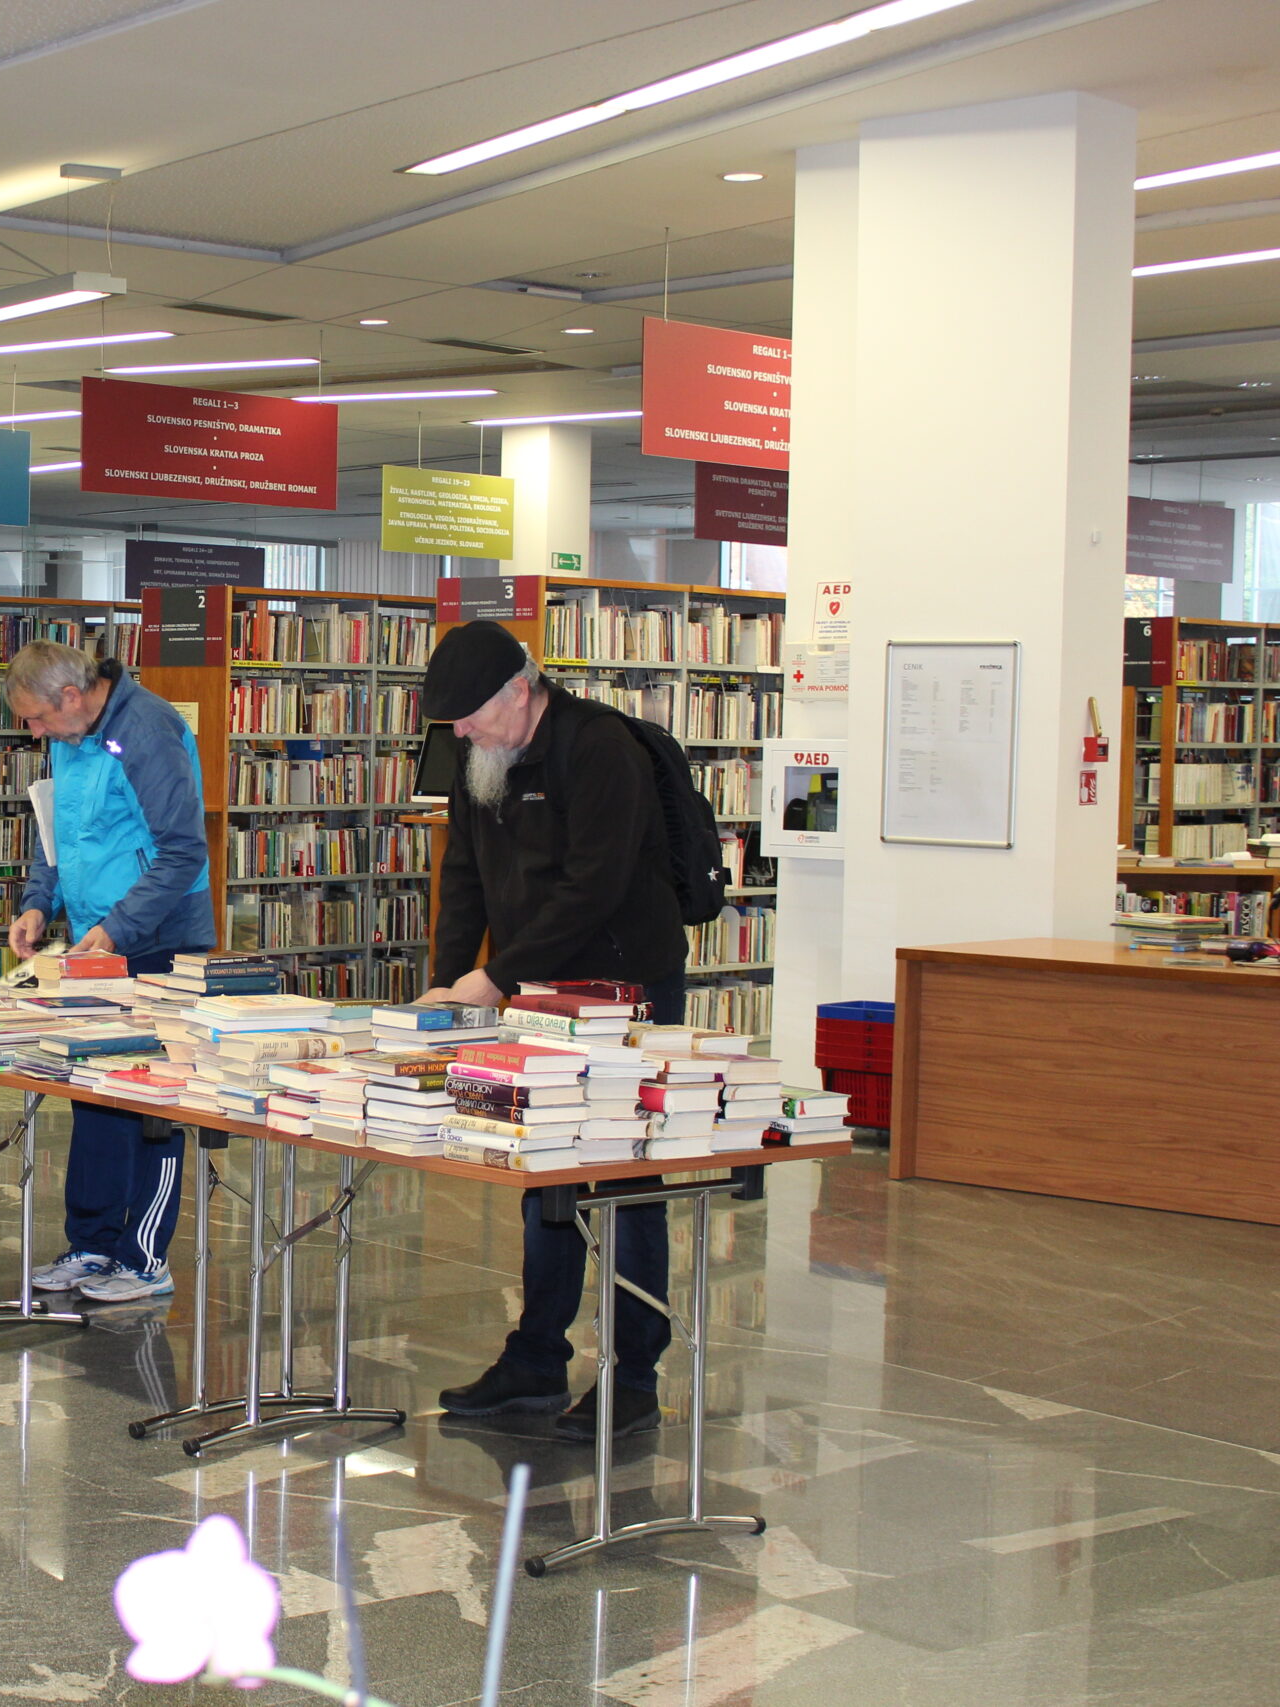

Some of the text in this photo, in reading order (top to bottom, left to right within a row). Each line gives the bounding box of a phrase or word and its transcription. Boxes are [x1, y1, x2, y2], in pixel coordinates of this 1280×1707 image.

[753, 345, 781, 358] REGALI
[707, 364, 752, 380] SLOVENSKO
[192, 397, 221, 409] REGALI
[724, 400, 768, 416] SLOVENSKA
[147, 414, 282, 436] SLOVENSKO PESNIŠTVO, DRAMATIKA
[665, 427, 709, 442] SLOVENSKI
[710, 432, 763, 450] LJUBEZENSKI,
[164, 444, 264, 462] SLOVENSKA KRATKA PROZA
[105, 468, 317, 494] SLOVENSKI LJUBEZENSKI, DRUŽINSKI, DRUŽBENI ROMANI
[432, 476, 452, 485] REGALI
[712, 474, 739, 484] SVETOVNA
[748, 487, 777, 498] PESNIŠTVO
[473, 504, 501, 512] EKOLOGIJA
[388, 519, 405, 527] JAVNA
[476, 527, 509, 536] SOCIOLOGIJA
[459, 541, 484, 549] SLOVARJI
[505, 585, 514, 599] 3
[823, 585, 851, 594] AED
[198, 596, 205, 608] 2
[1143, 625, 1152, 636] 6
[233, 650, 239, 658] K
[825, 684, 849, 692] POMOČ
[805, 753, 829, 765] AED
[308, 867, 314, 875] L
[375, 933, 381, 941] P
[544, 1016, 567, 1031] drevo
